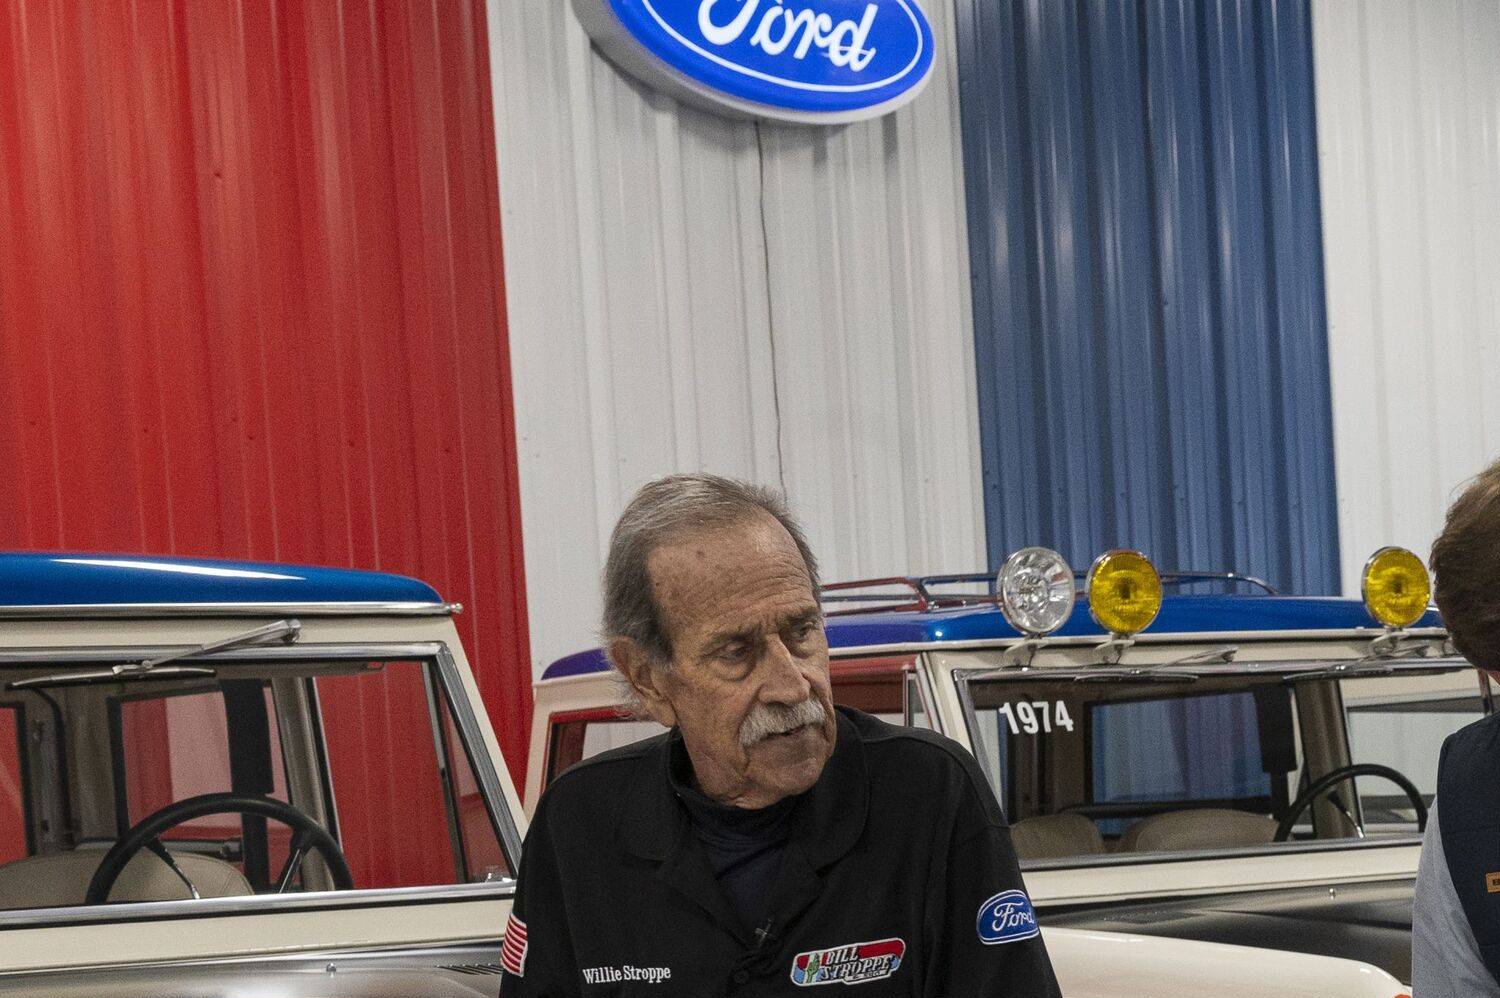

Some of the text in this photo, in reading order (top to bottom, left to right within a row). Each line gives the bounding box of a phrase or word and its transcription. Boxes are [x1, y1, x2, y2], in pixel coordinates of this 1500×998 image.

[999, 700, 1074, 736] 1974
[825, 945, 859, 965] BILL
[582, 965, 672, 984] Willie Stroppe
[820, 954, 895, 980] STROPPE
